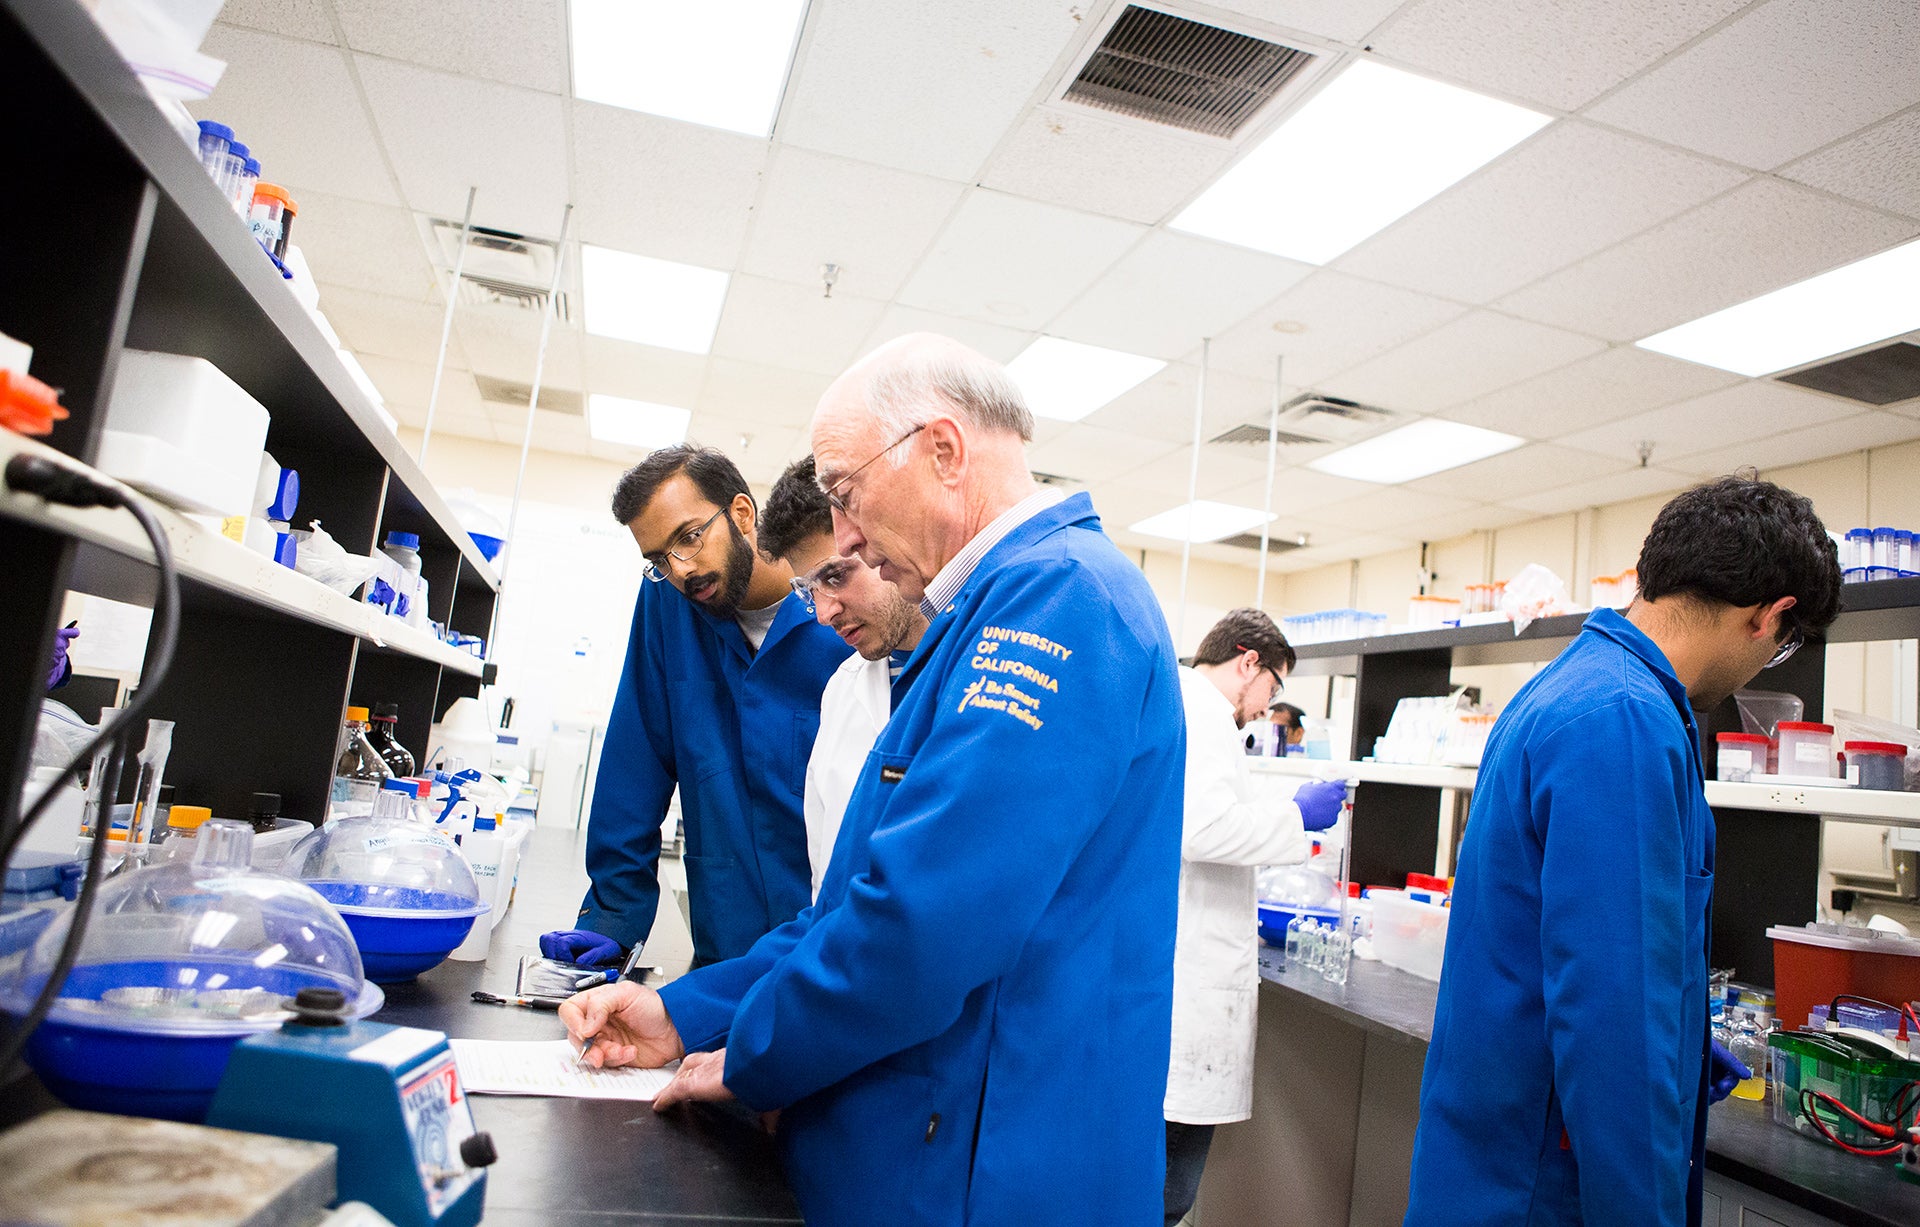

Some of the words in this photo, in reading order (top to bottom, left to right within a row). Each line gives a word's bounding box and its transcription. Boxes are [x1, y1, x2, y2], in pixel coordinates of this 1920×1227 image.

[976, 640, 1000, 655] OF
[982, 626, 1073, 661] UNIVERSITY
[971, 655, 1059, 693] CALIFORNIA
[969, 694, 1008, 711] About
[1007, 701, 1044, 731] Safety
[984, 680, 1002, 695] Be
[1003, 683, 1041, 710] Smart
